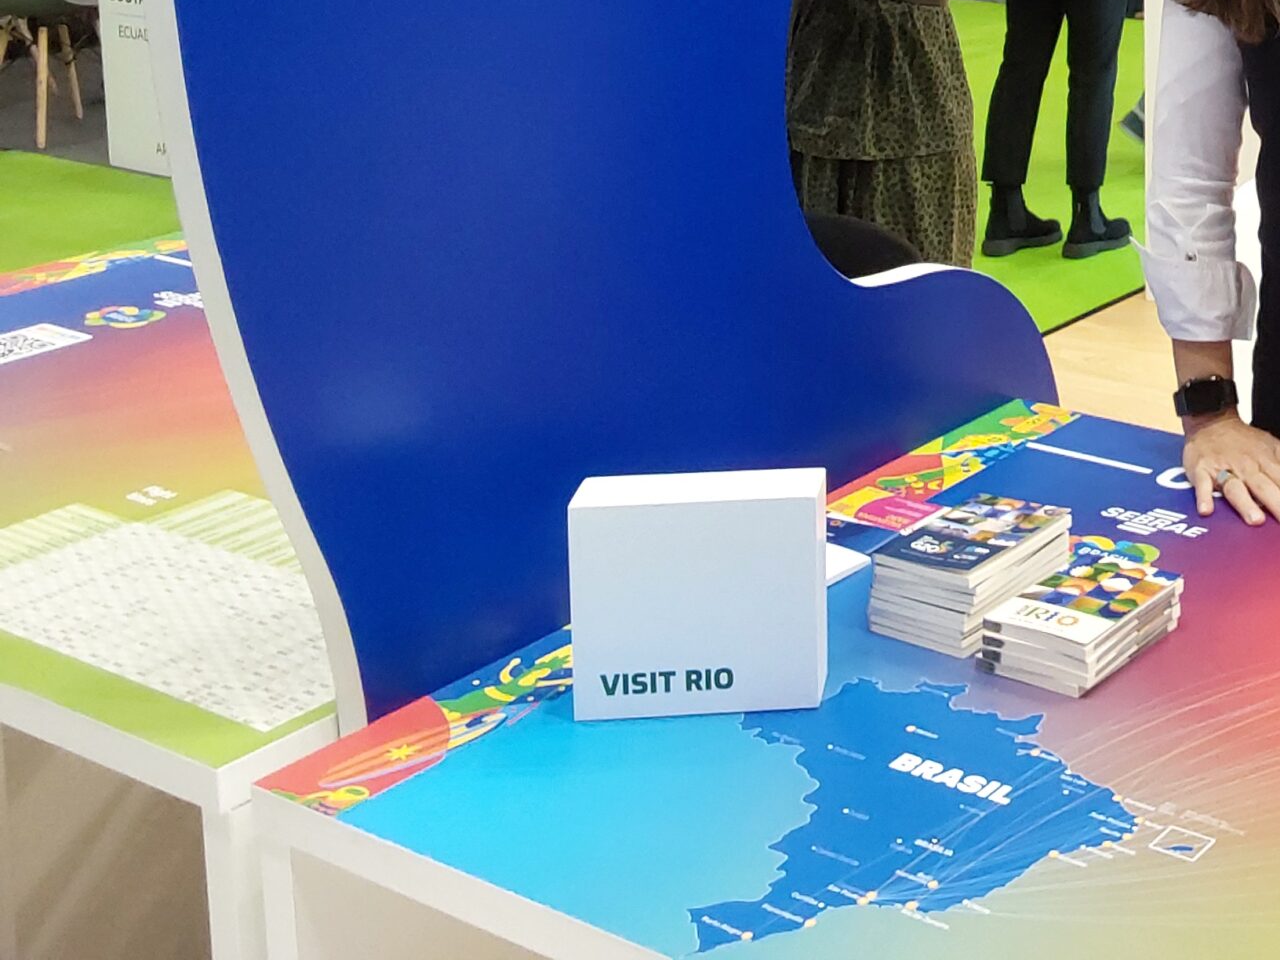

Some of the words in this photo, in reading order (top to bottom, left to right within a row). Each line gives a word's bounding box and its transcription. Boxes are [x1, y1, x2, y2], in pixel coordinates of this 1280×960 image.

[1101, 507, 1208, 538] SEBRAE
[600, 671, 676, 696] VISIT
[685, 667, 734, 692] RIO
[889, 752, 1013, 805] BRASIL
